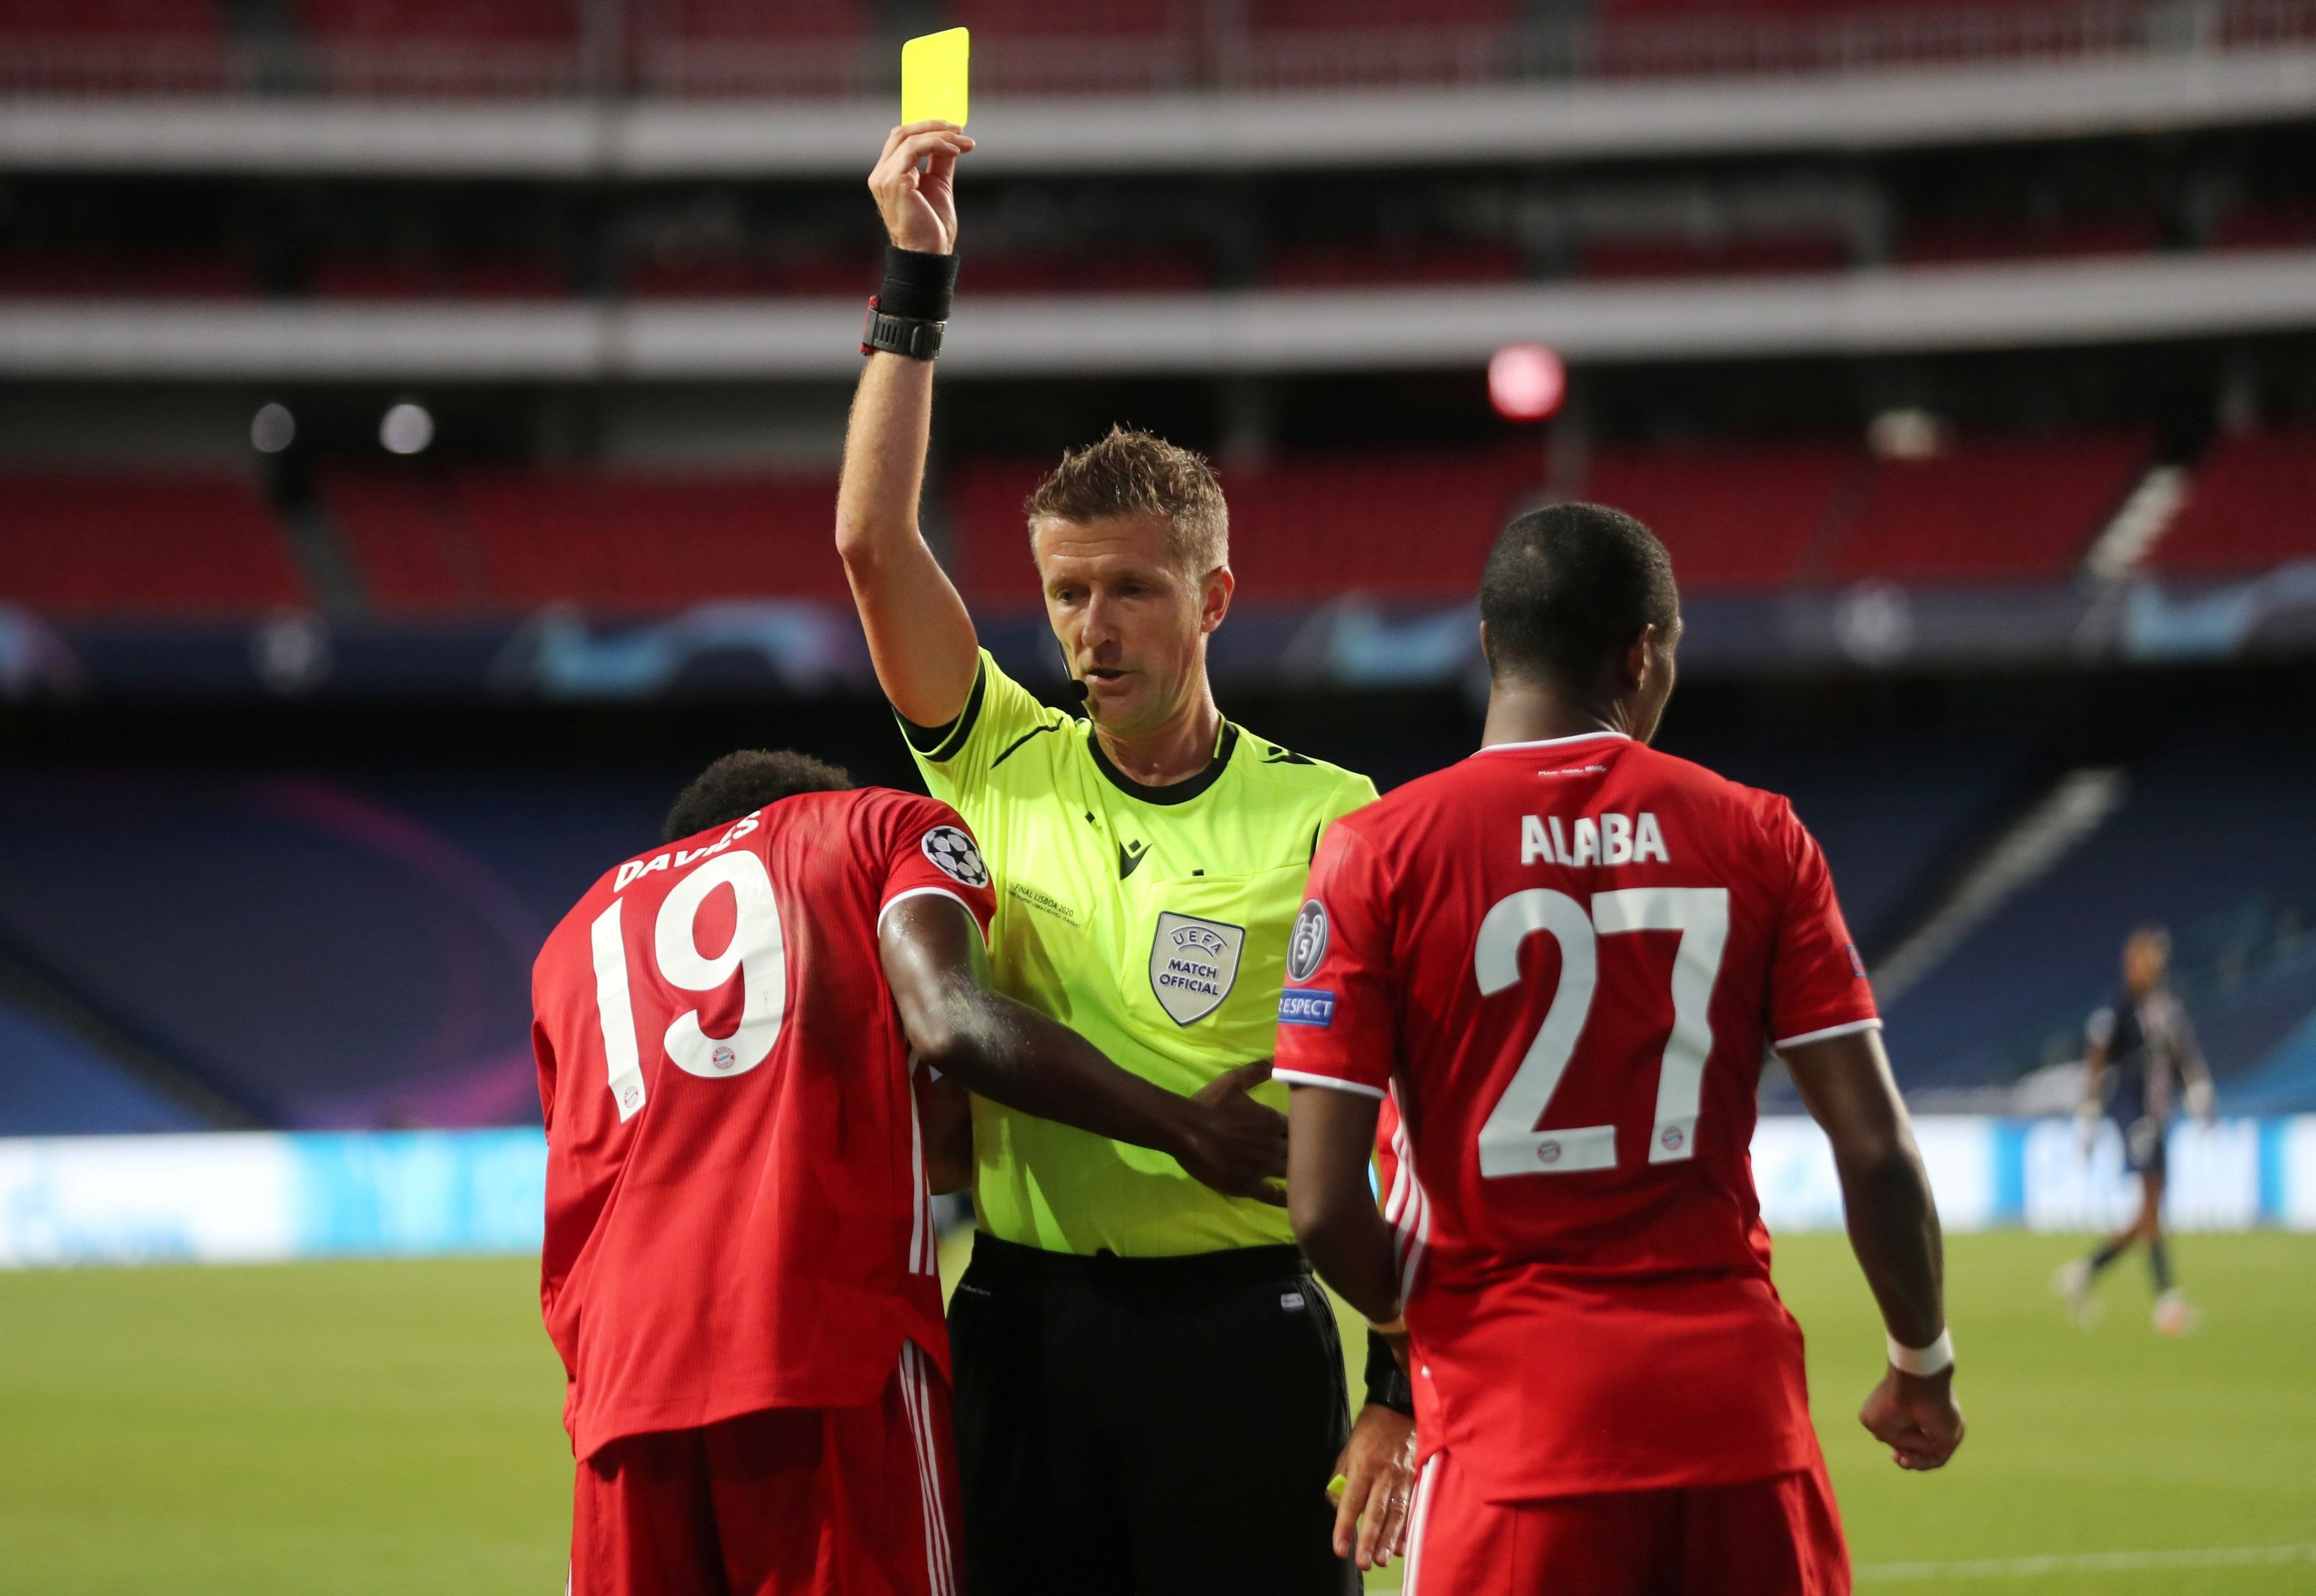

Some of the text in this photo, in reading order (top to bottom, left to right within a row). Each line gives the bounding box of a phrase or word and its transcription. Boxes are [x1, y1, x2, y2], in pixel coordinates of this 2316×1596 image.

[1521, 813, 1670, 868] ALABA
[1014, 884, 1034, 898] FINAL
[1034, 893, 1058, 909] LISBOA
[1058, 904, 1074, 917] 2020
[1173, 930, 1222, 955] UEFA
[1297, 938, 1309, 961] 5
[1168, 958, 1217, 979] MATCH
[591, 850, 786, 1123] 19
[1159, 973, 1219, 996] OFFICIAL
[1475, 887, 1730, 1179] 27
